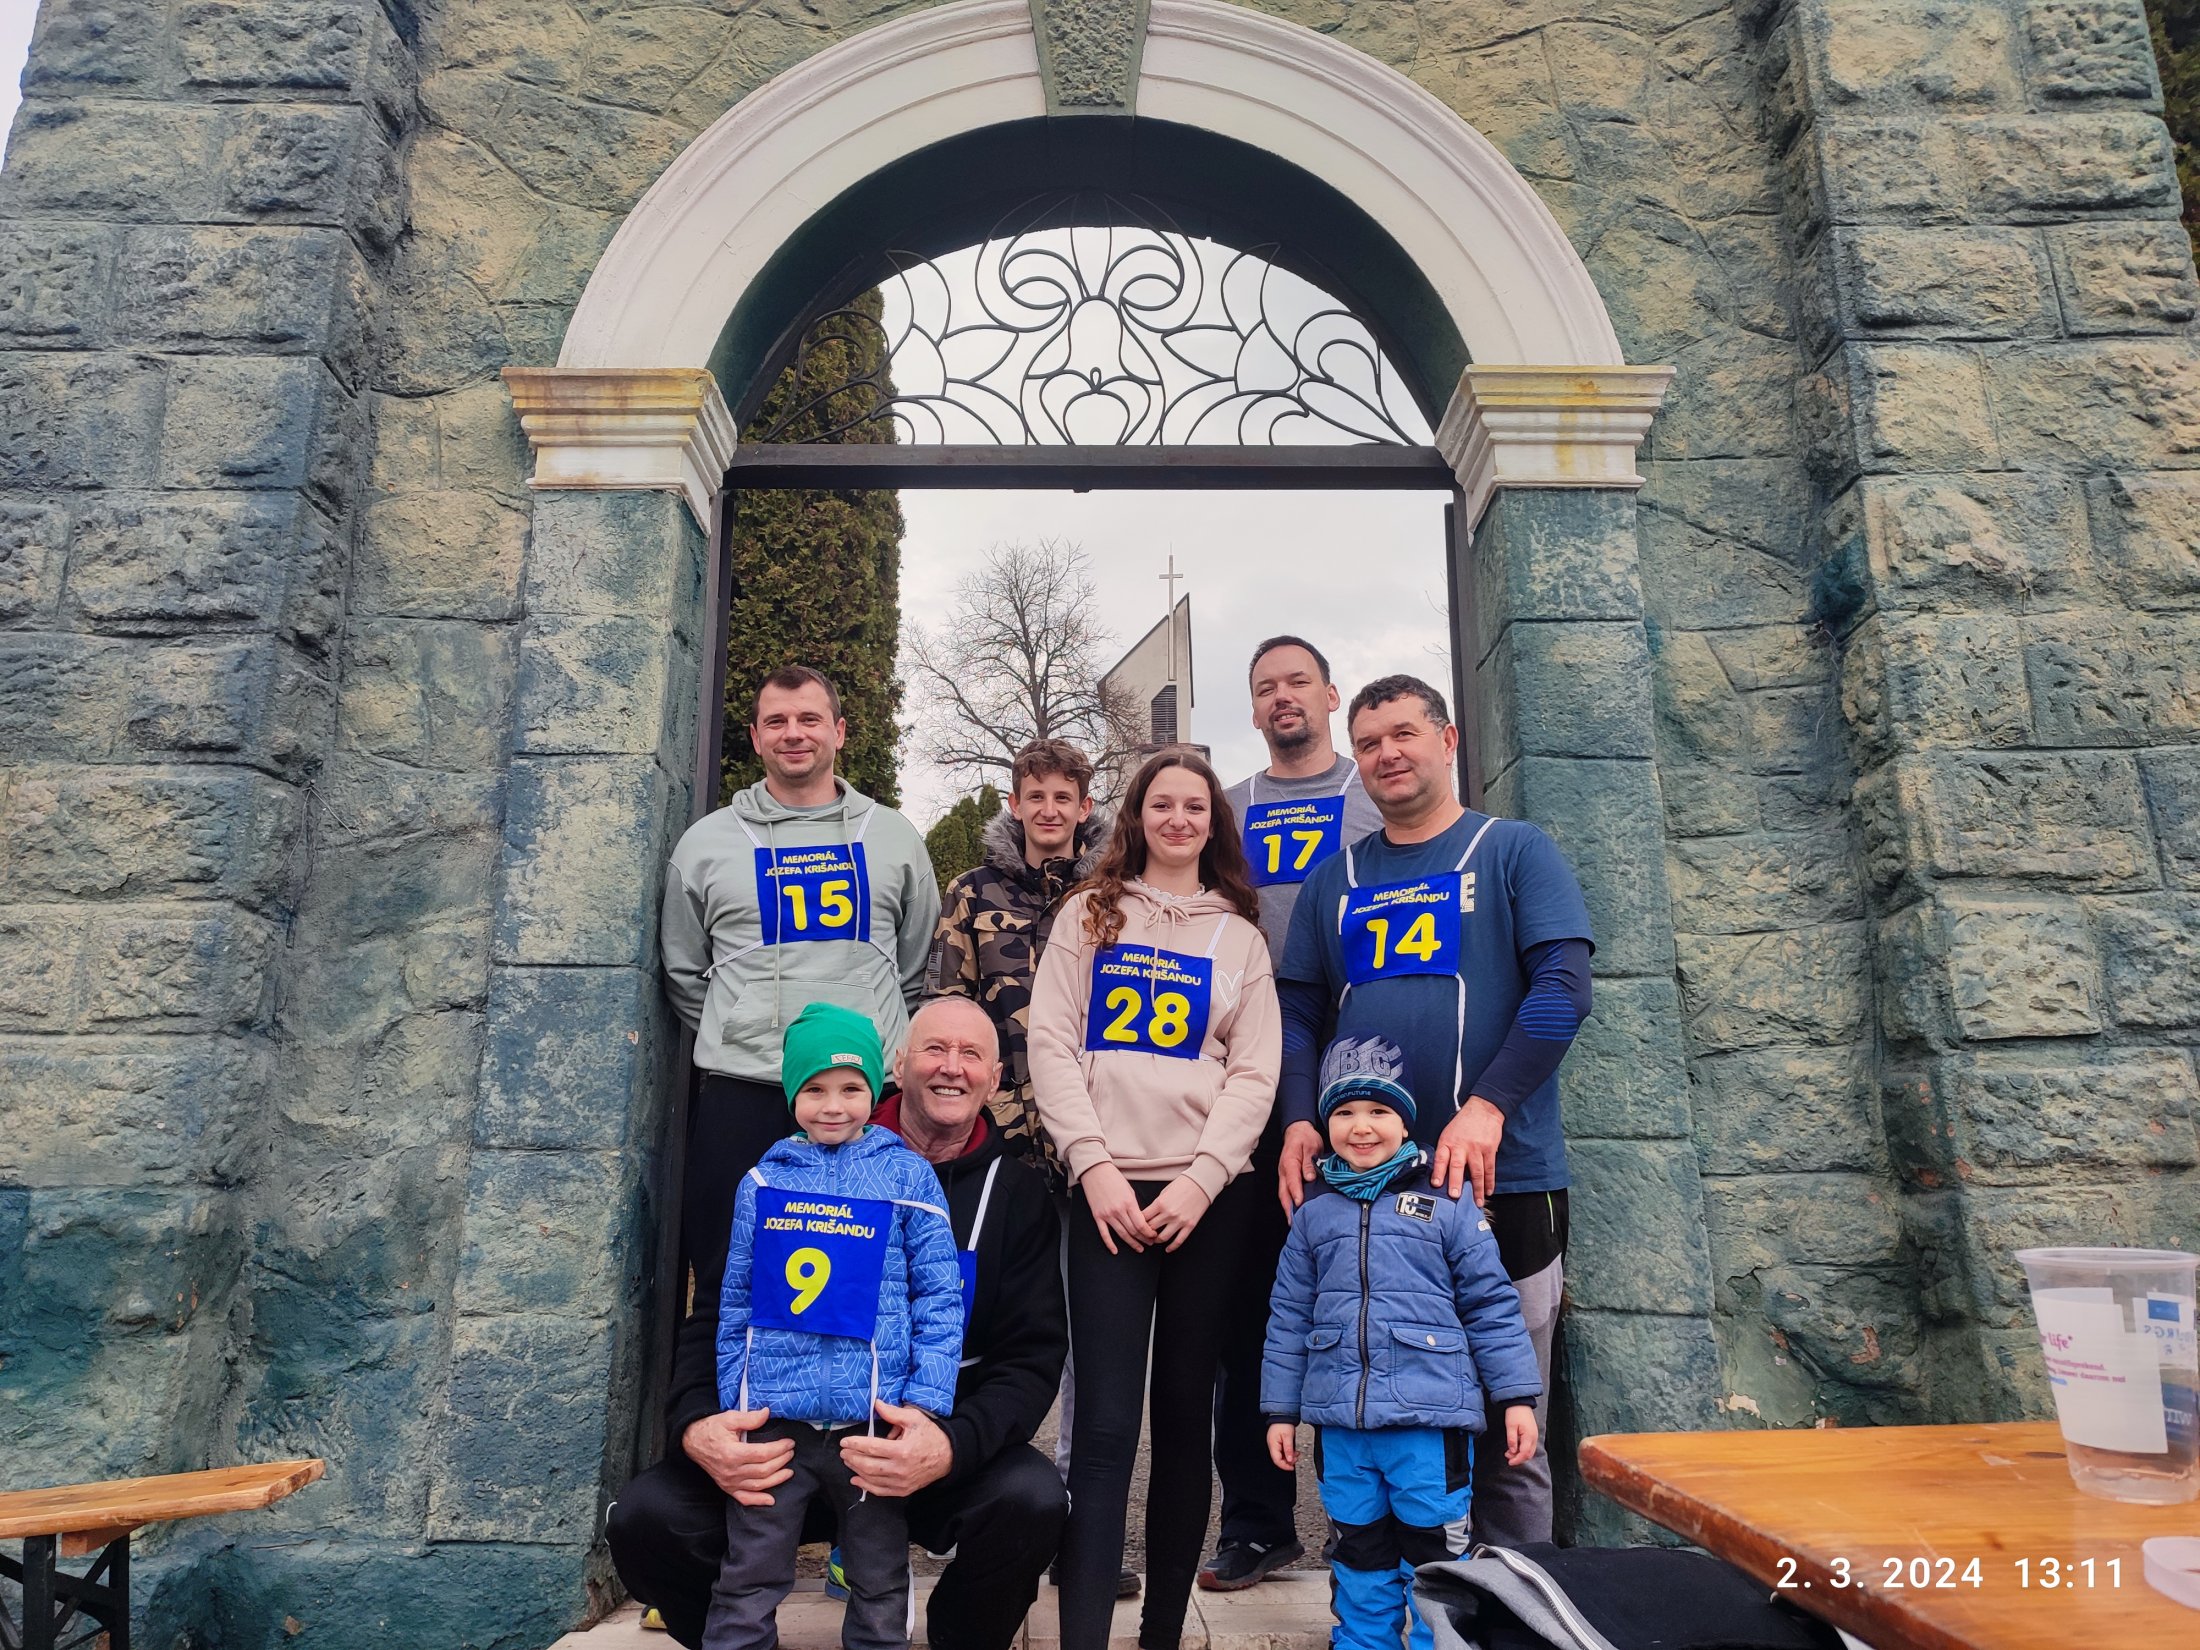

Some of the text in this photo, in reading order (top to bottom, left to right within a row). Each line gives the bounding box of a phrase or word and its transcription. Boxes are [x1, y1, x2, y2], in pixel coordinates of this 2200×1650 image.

[1267, 804, 1317, 817] MEMORIÁL
[1249, 813, 1334, 830] JOZEFA KRIŠANDU
[782, 850, 838, 864] MEMORIÁL
[1263, 830, 1324, 873] 17
[765, 866, 802, 877] JOZEFA
[1373, 883, 1430, 902] MEMORIÁL
[1391, 891, 1450, 904] KRIŠANDU
[783, 880, 853, 931] 15
[1366, 912, 1442, 969] 14
[1121, 952, 1182, 970] MEMORIÁL
[1100, 964, 1202, 986] JOZEFA KRIŠANDU
[1103, 986, 1191, 1048] 28
[784, 1201, 854, 1219] MEMORIÁL
[763, 1217, 876, 1239] JOZEFA KRIŠANDU
[785, 1247, 832, 1316] 9
